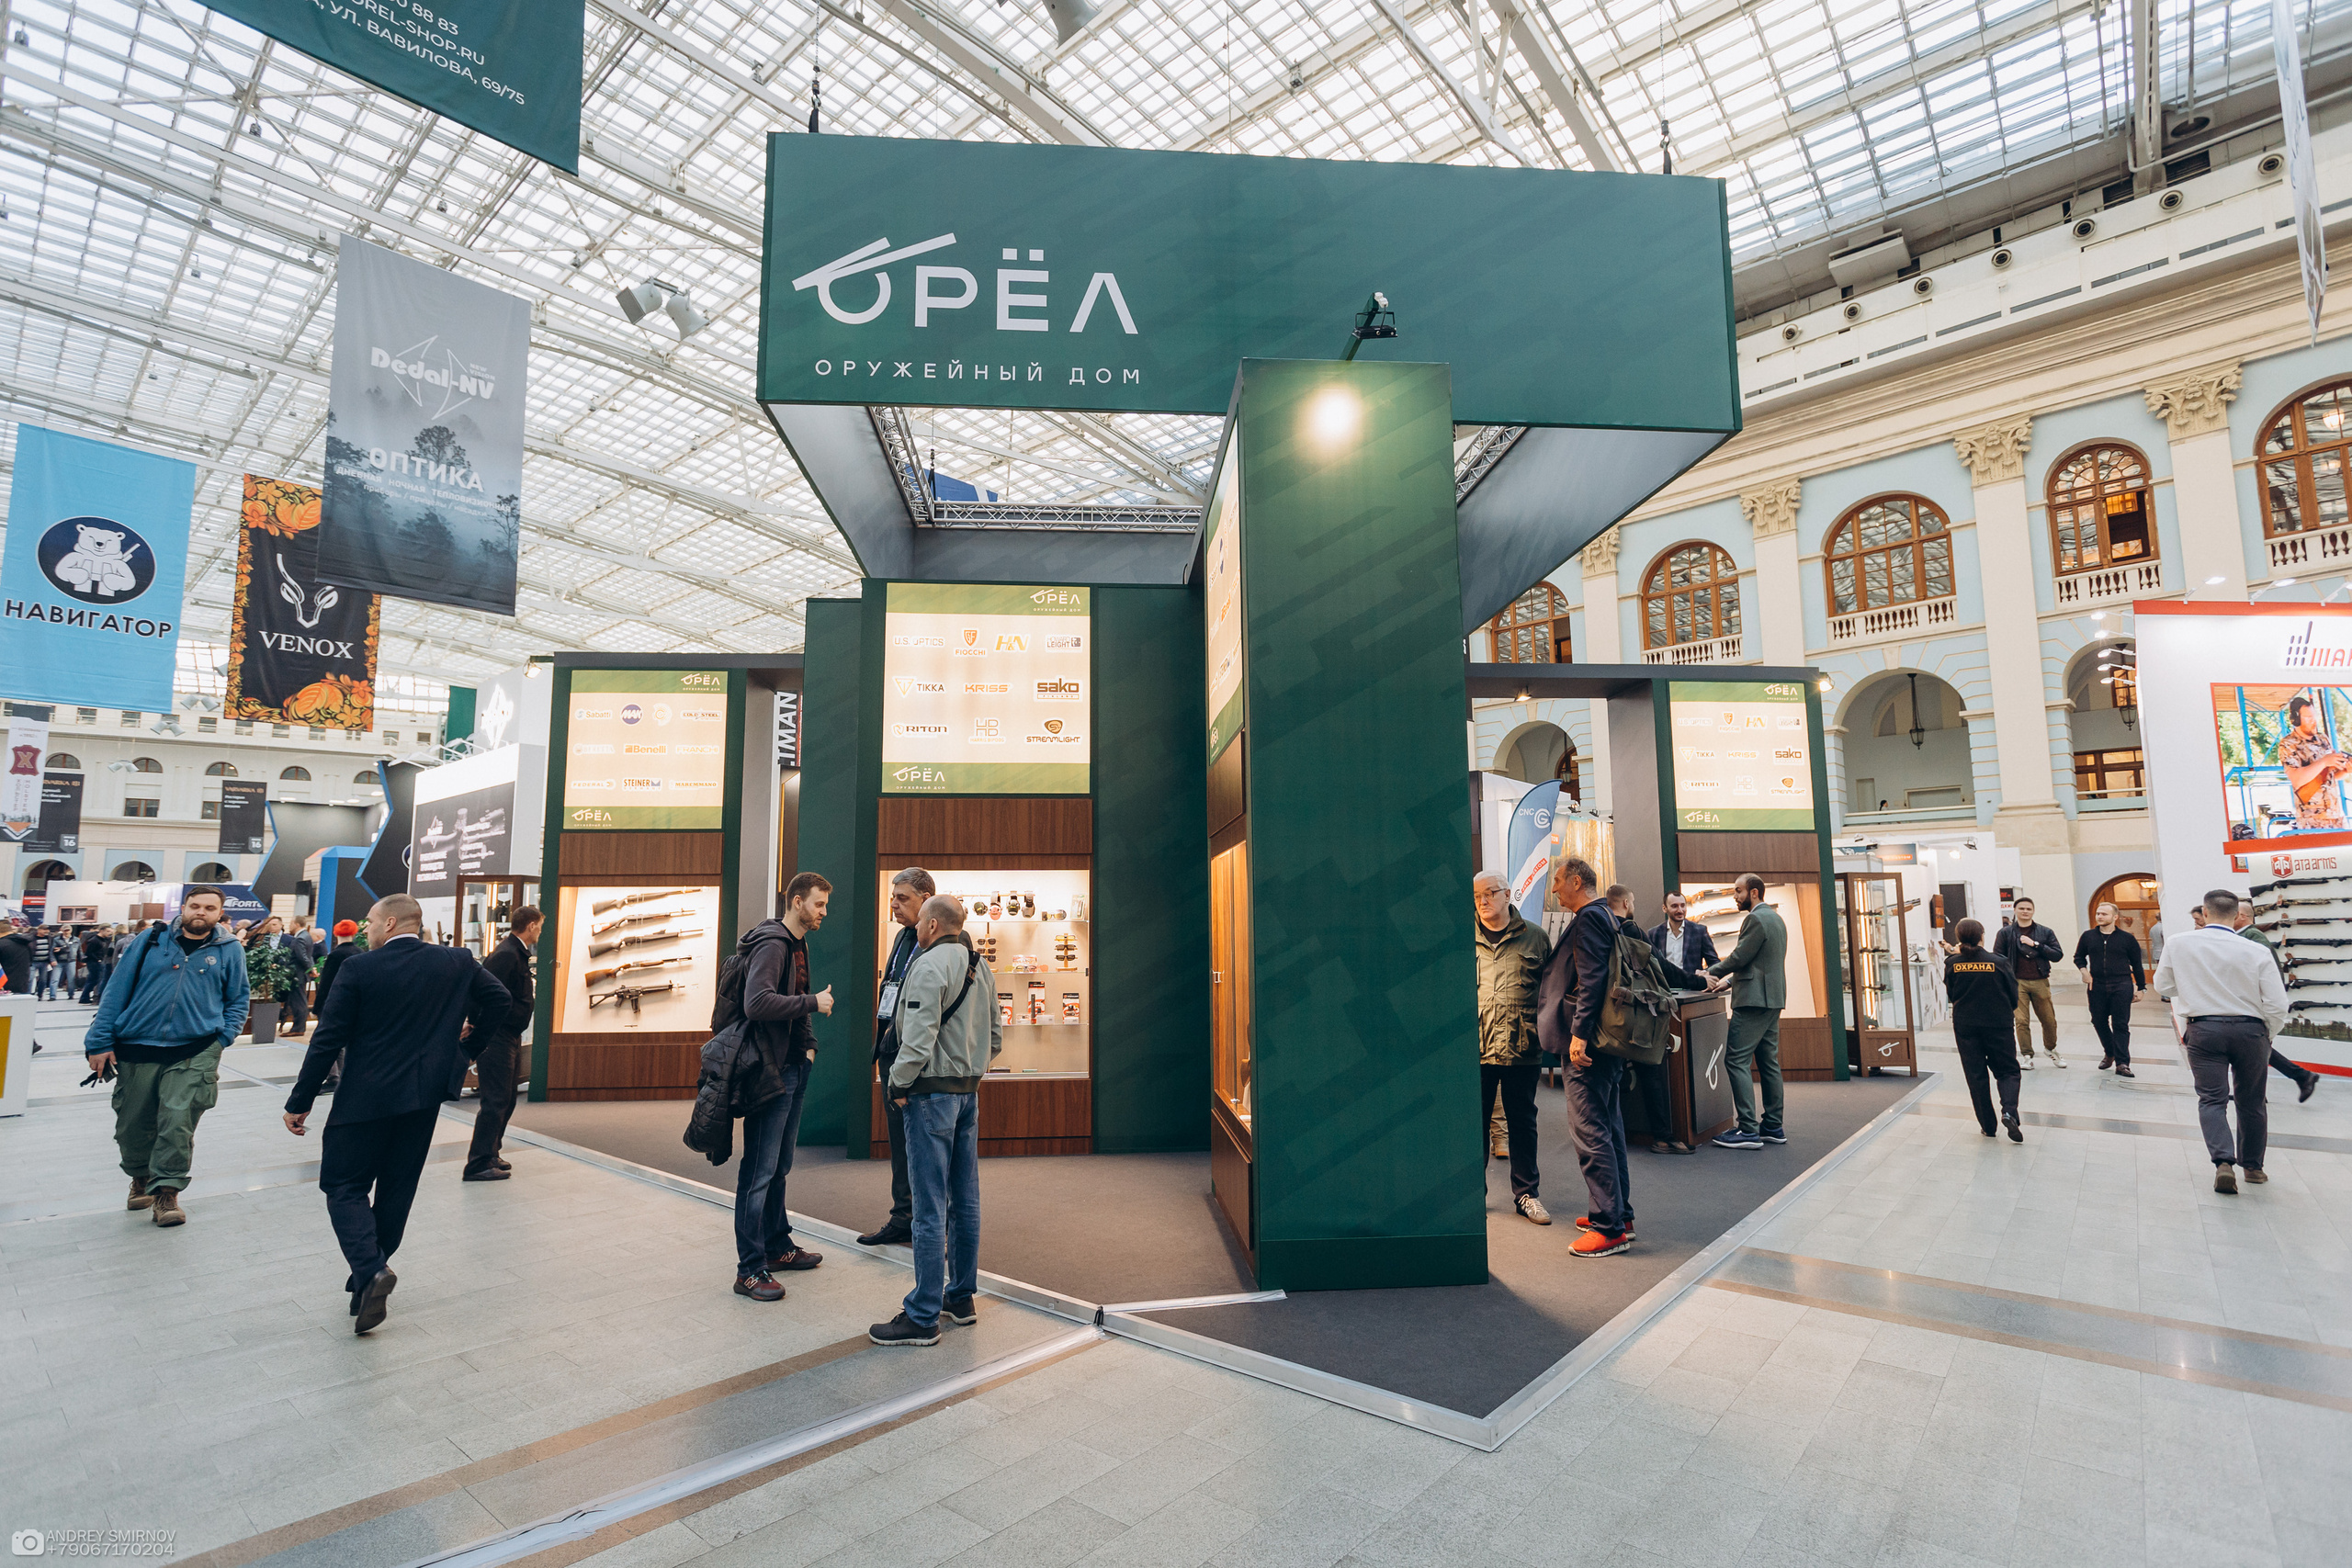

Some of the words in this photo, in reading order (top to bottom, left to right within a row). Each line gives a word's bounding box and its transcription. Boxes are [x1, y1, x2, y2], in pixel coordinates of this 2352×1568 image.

[412, 3, 435, 23] 88
[438, 17, 459, 36] 83
[331, 1, 361, 27] УЛ.
[368, 19, 478, 85] ВАВИЛОВА,
[481, 76, 526, 105] 69/75
[371, 346, 494, 400] Dedal-NV
[469, 363, 487, 372] NEW
[469, 369, 495, 380] VISION
[815, 359, 1042, 382] ОРУЖЕЙНЫЙ
[1069, 367, 1140, 386] ДОМ
[369, 447, 484, 492] ОПТИКА
[336, 466, 382, 483] ДНЕВНАЯ
[389, 479, 426, 493] НОЧНАЯ
[431, 489, 512, 513] ТЕПЛОВИЗИОННАЯ
[5, 599, 173, 638] НАВИГАТОР
[258, 630, 354, 660] VENOX
[996, 636, 1029, 650] H&N
[917, 683, 944, 692] TIKKA
[965, 684, 1008, 693] KRISS
[1037, 678, 1080, 693] sako
[633, 745, 666, 753] Benelli
[1775, 748, 1802, 759] sako
[1519, 808, 1534, 817] CNC
[2312, 857, 2337, 870] arms
[1955, 963, 1993, 971] ОХРАНА
